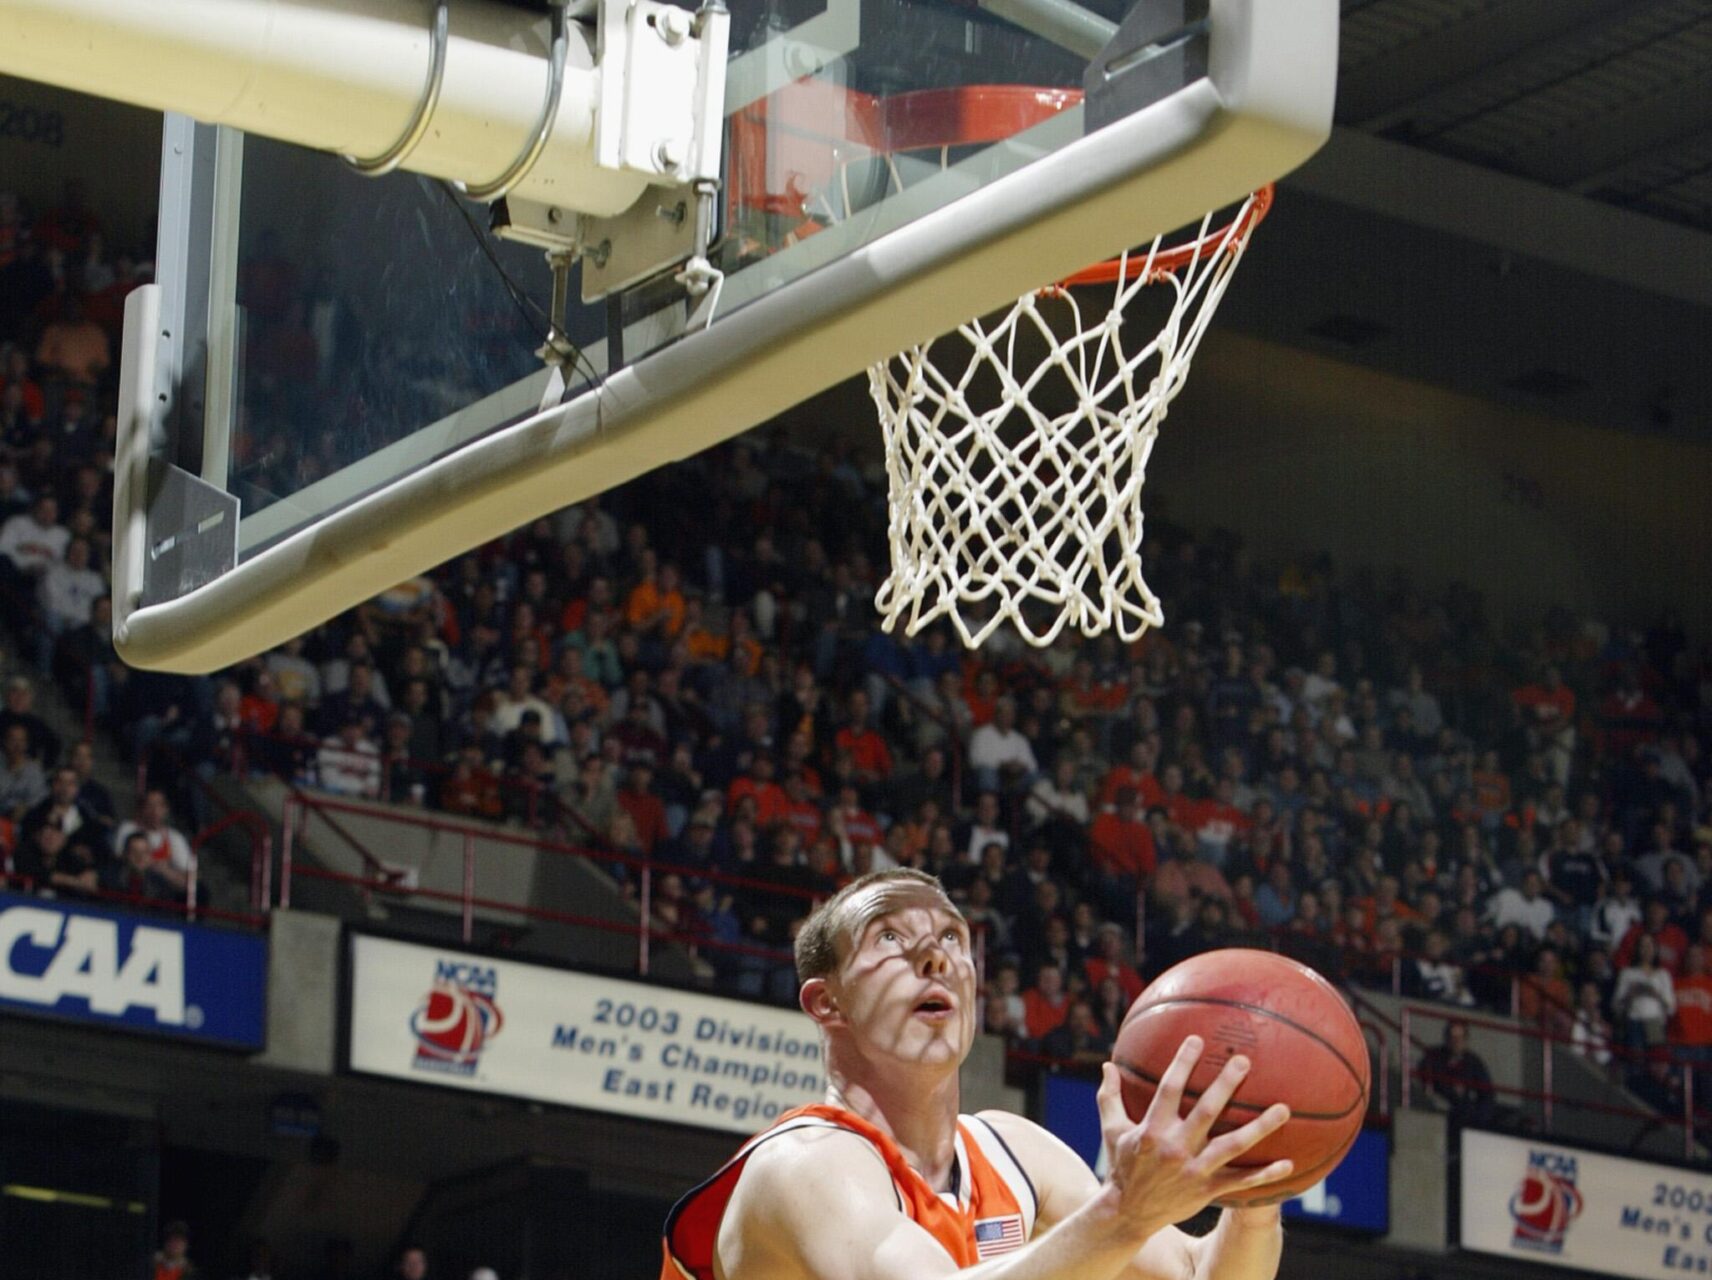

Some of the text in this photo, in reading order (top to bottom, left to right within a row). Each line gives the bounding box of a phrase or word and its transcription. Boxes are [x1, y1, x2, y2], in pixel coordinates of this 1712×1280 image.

[437, 958, 496, 987] NCAA
[552, 1024, 644, 1063] Men's
[594, 997, 820, 1060] 2003 Division
[602, 1068, 676, 1102] East
[1621, 1207, 1692, 1239] Men's
